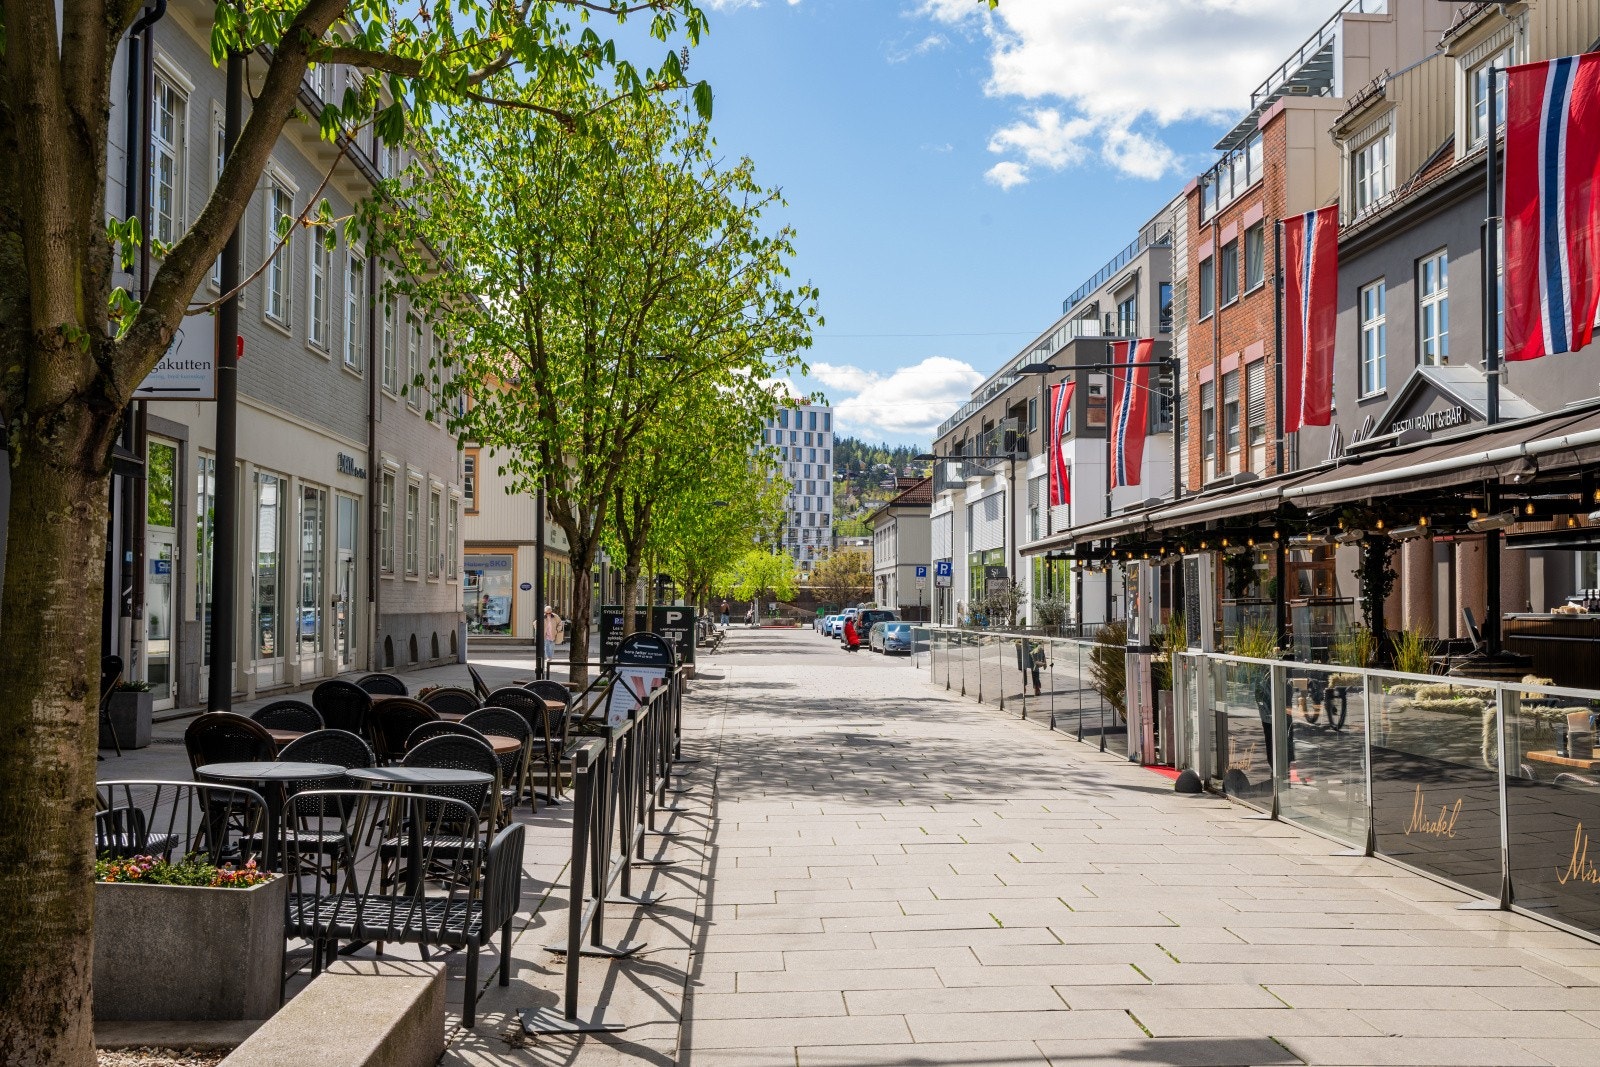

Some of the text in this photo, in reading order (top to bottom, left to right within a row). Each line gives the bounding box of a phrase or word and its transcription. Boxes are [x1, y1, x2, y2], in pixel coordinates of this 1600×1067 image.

[1438, 411, 1444, 428] &
[1446, 405, 1462, 426] BAR
[918, 567, 925, 576] P
[666, 611, 683, 624] P
[1403, 783, 1463, 839] Mirabel
[1555, 822, 1600, 885] Mir
